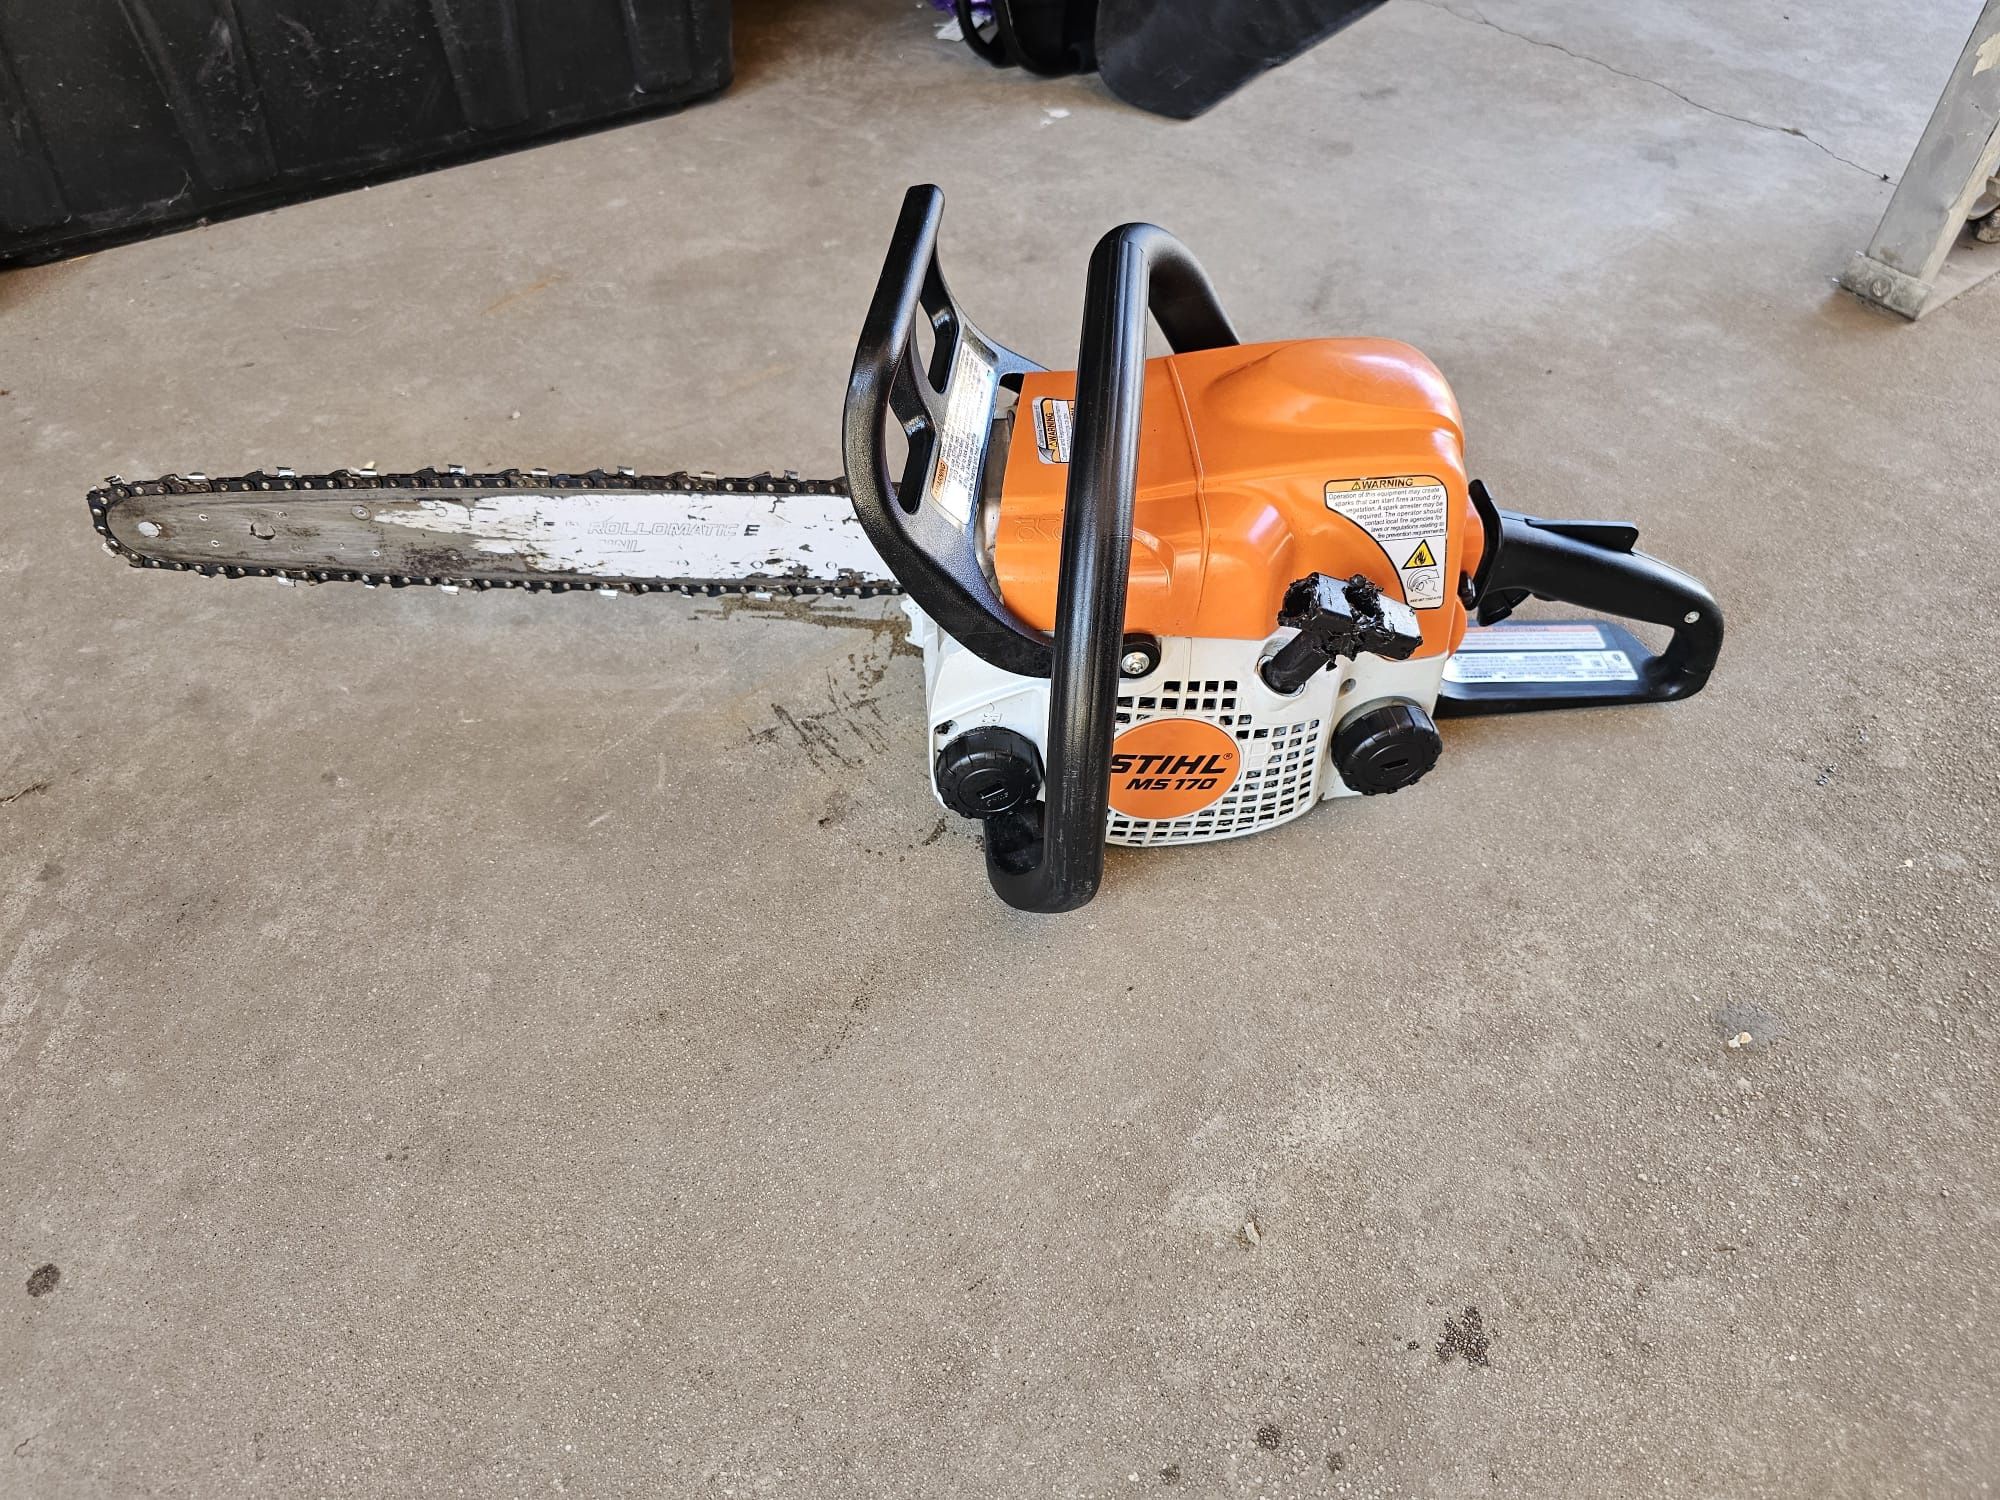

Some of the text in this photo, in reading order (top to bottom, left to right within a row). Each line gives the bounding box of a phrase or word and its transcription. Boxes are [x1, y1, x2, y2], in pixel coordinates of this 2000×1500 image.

[1045, 412, 1057, 442] WARNING
[1362, 479, 1413, 490] WARNING
[588, 521, 760, 537] ROLLOMATIC E
[1126, 778, 1218, 790] MS 170
